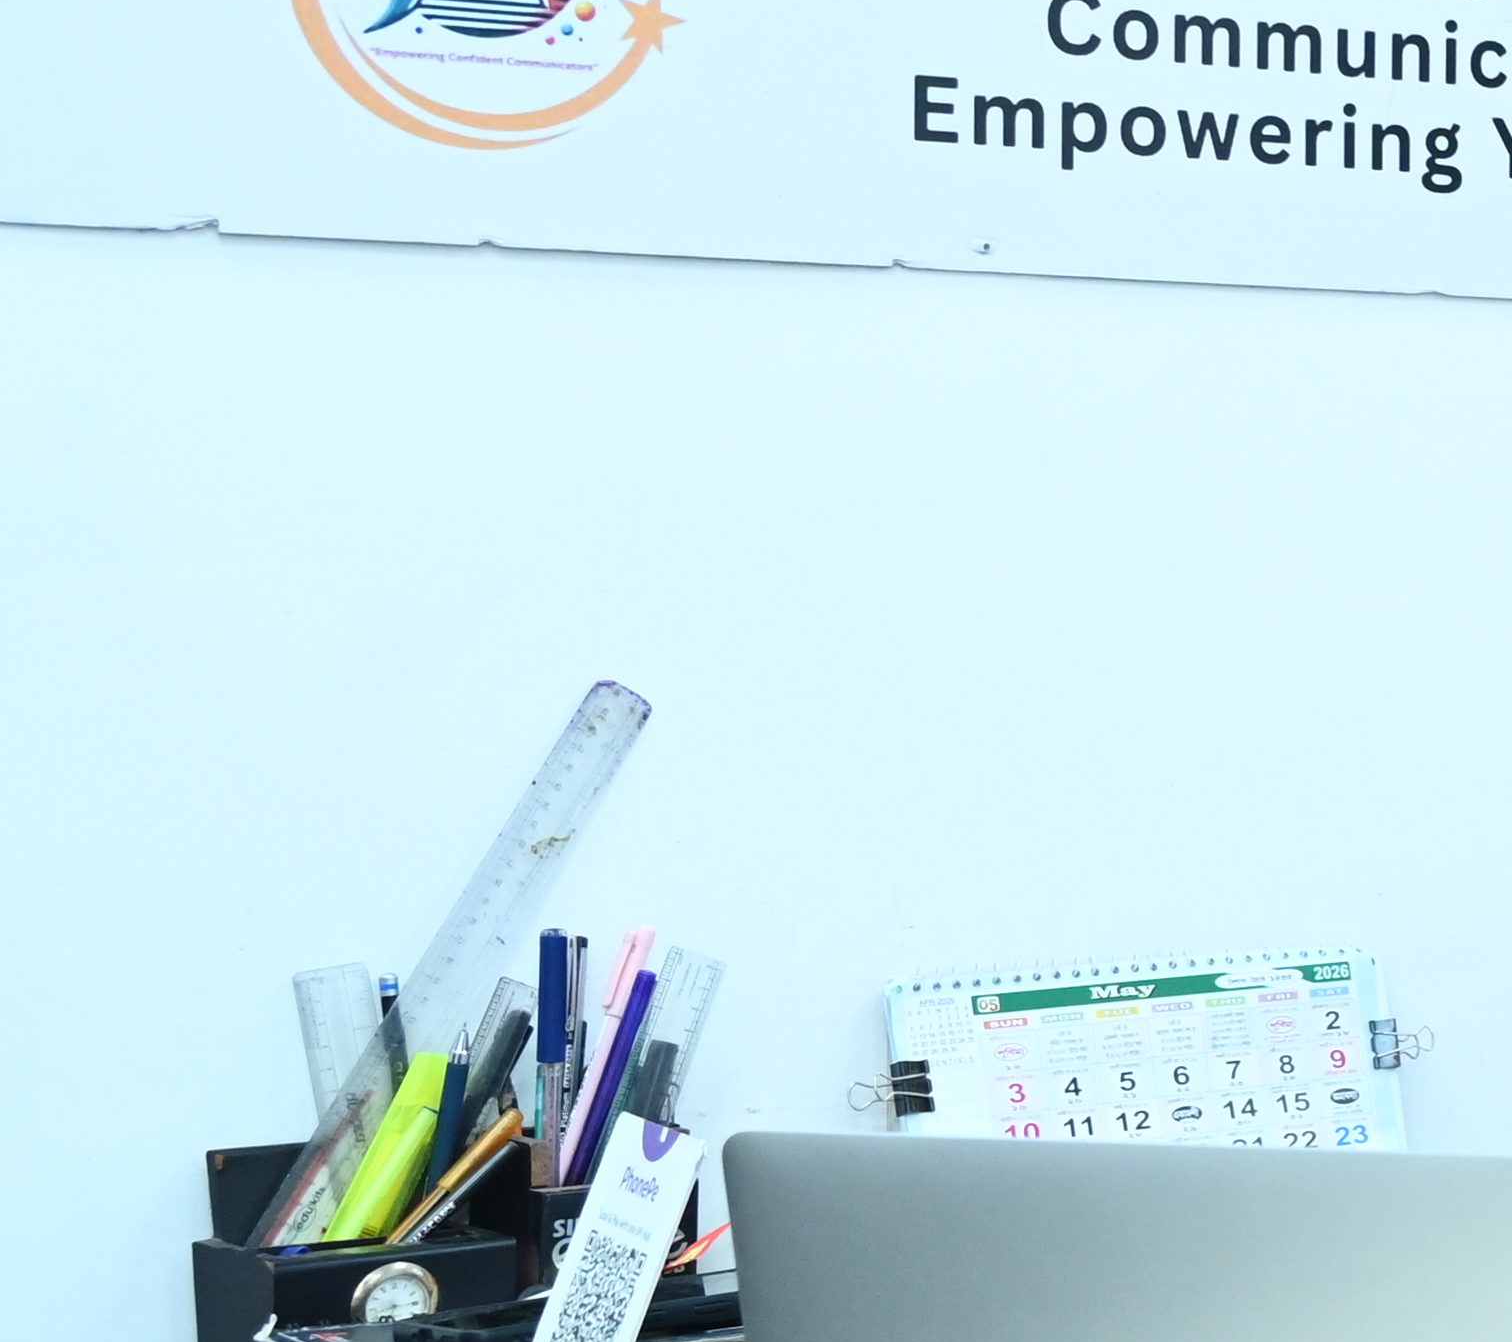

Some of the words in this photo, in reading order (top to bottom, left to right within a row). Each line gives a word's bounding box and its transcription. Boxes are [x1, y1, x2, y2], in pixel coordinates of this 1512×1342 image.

[449, 53, 503, 64] Confident
[913, 73, 1463, 195] Empowering
[979, 997, 998, 1011] 05
[1089, 984, 1156, 1000] May
[1314, 964, 1349, 980] 2026
[989, 1019, 1024, 1028] SUN
[1044, 1013, 1082, 1022] MON
[1103, 1008, 1133, 1017] TUE
[1155, 1002, 1191, 1012] WED
[1211, 997, 1243, 1006] THU
[1266, 993, 1291, 1002] FRI
[1316, 987, 1342, 996] SAT
[1325, 1011, 1341, 1030] 2
[1008, 1083, 1026, 1103] 3
[1065, 1077, 1082, 1096] 4
[1120, 1071, 1136, 1091] 5
[1173, 1066, 1190, 1085] 6
[1226, 1060, 1241, 1079] 7
[1279, 1055, 1295, 1074] 8
[1330, 1050, 1346, 1069] 9
[1005, 1123, 1040, 1138] 10
[1063, 1116, 1094, 1137] 11
[1116, 1110, 1151, 1132] 12
[1223, 1098, 1258, 1119] 14
[1276, 1093, 1310, 1113] 15
[1283, 1131, 1319, 1148] 22
[1335, 1125, 1369, 1146] 23
[620, 1166, 660, 1202] PhonePe
